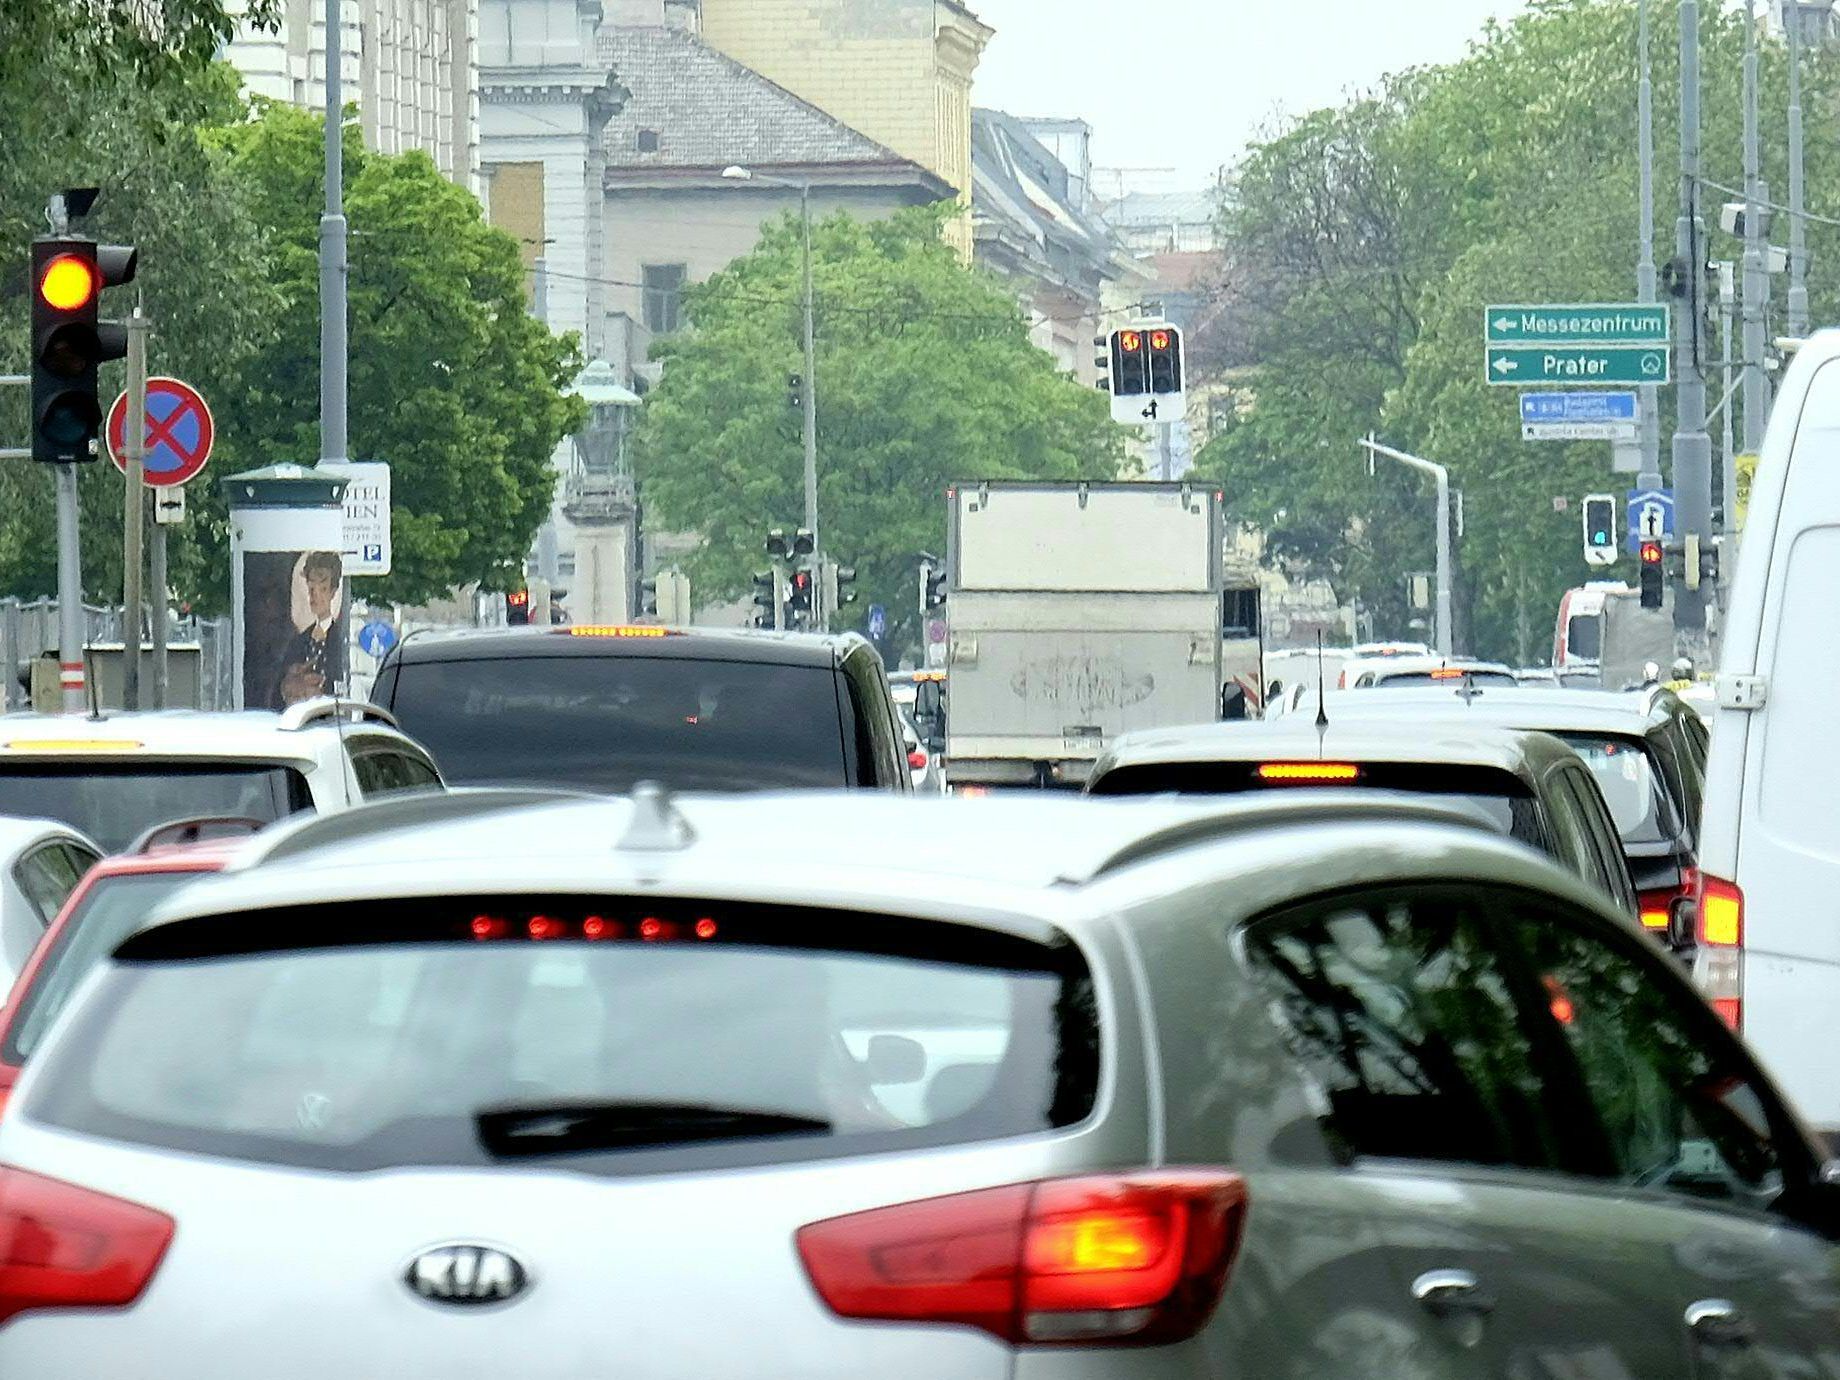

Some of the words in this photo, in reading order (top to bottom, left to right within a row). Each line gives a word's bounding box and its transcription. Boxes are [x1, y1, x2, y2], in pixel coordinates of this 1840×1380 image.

[1521, 314, 1662, 333] Messezentrum
[1543, 354, 1608, 375] Prater
[343, 487, 385, 500] TEL
[346, 504, 377, 518] IEN
[417, 1253, 514, 1298] KIA
